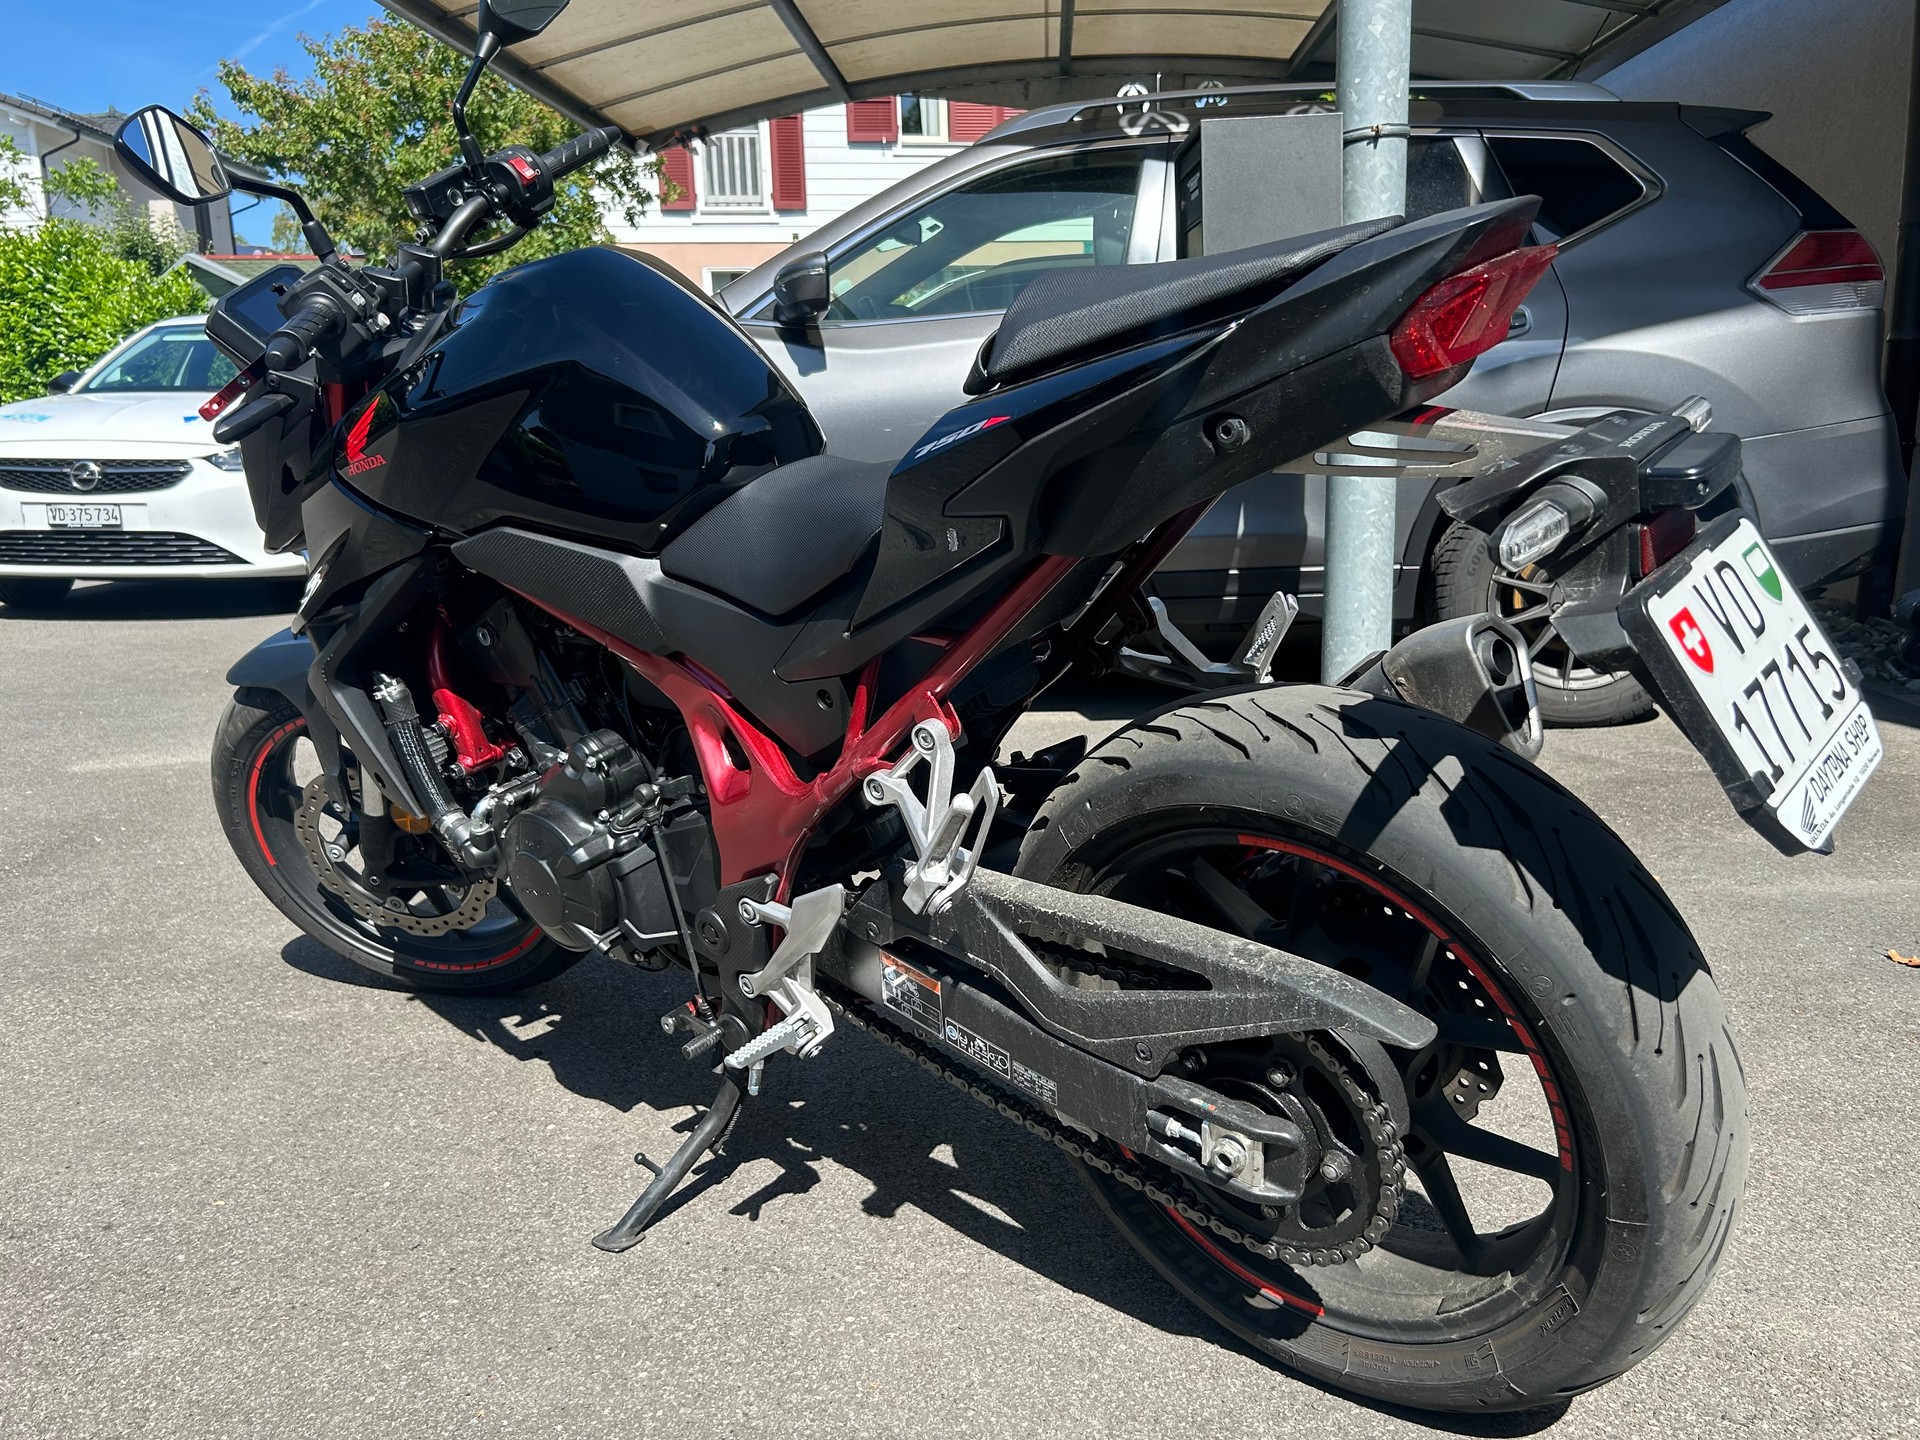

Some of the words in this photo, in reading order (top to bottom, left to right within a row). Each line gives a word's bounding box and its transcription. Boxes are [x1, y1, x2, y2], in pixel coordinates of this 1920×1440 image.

[1617, 421, 1669, 448] HONDA
[347, 454, 388, 476] HONDA
[1692, 560, 1766, 655] VD
[1730, 624, 1846, 784] 17715
[1808, 740, 1853, 803] DAYTONA
[1844, 713, 1870, 756] SHOP
[1808, 818, 1830, 846] HONDA
[1353, 1349, 1397, 1364] TUBELESS
[1361, 1360, 1391, 1373] RADIAL
